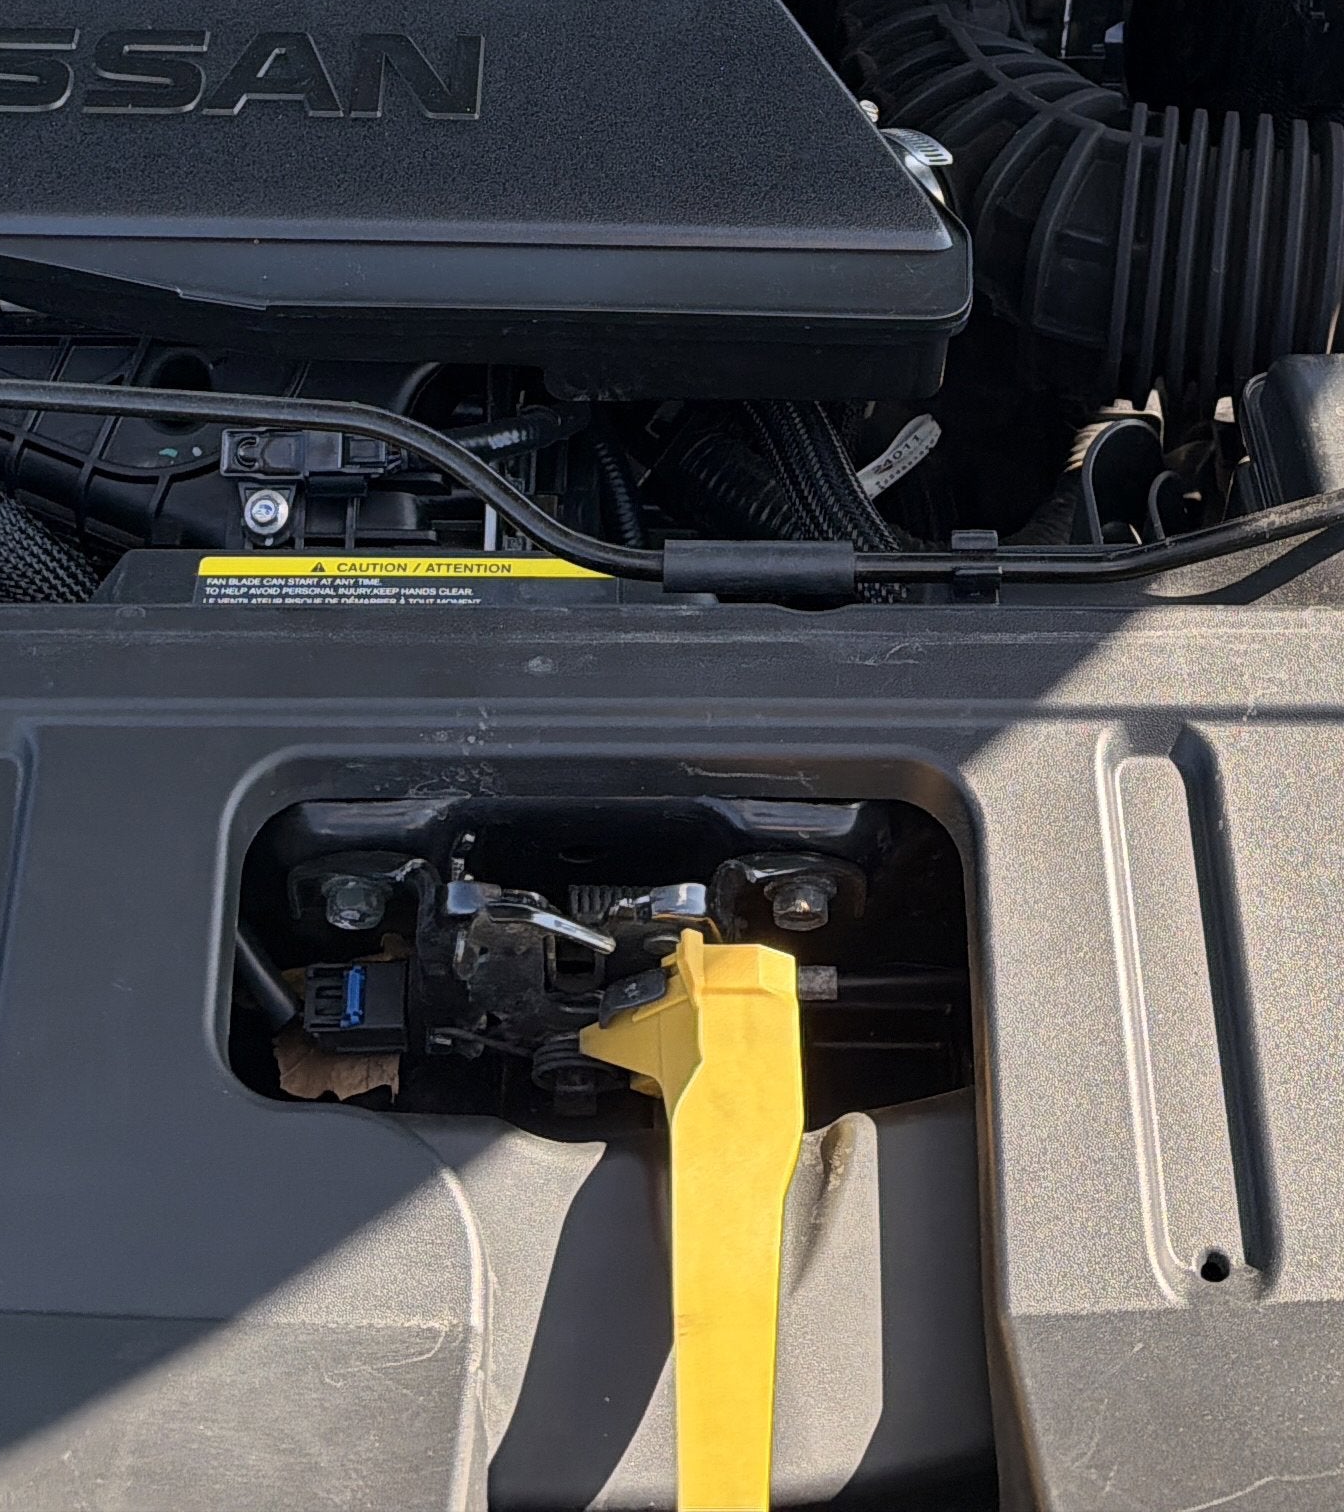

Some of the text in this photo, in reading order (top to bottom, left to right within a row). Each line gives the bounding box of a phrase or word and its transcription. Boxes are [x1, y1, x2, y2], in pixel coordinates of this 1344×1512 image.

[337, 562, 407, 573] CAUTION
[425, 562, 512, 574] ATTENTION
[207, 578, 226, 586] FAN
[229, 578, 261, 586] BLADE
[263, 578, 285, 586] CAN
[287, 578, 318, 586] START
[320, 578, 333, 586] AT
[334, 578, 355, 586] ANY
[205, 587, 219, 596] TO
[221, 587, 247, 596] HELP
[249, 587, 279, 596] AVOID
[282, 587, 336, 596] PERSONAL
[401, 587, 436, 596] HANDS
